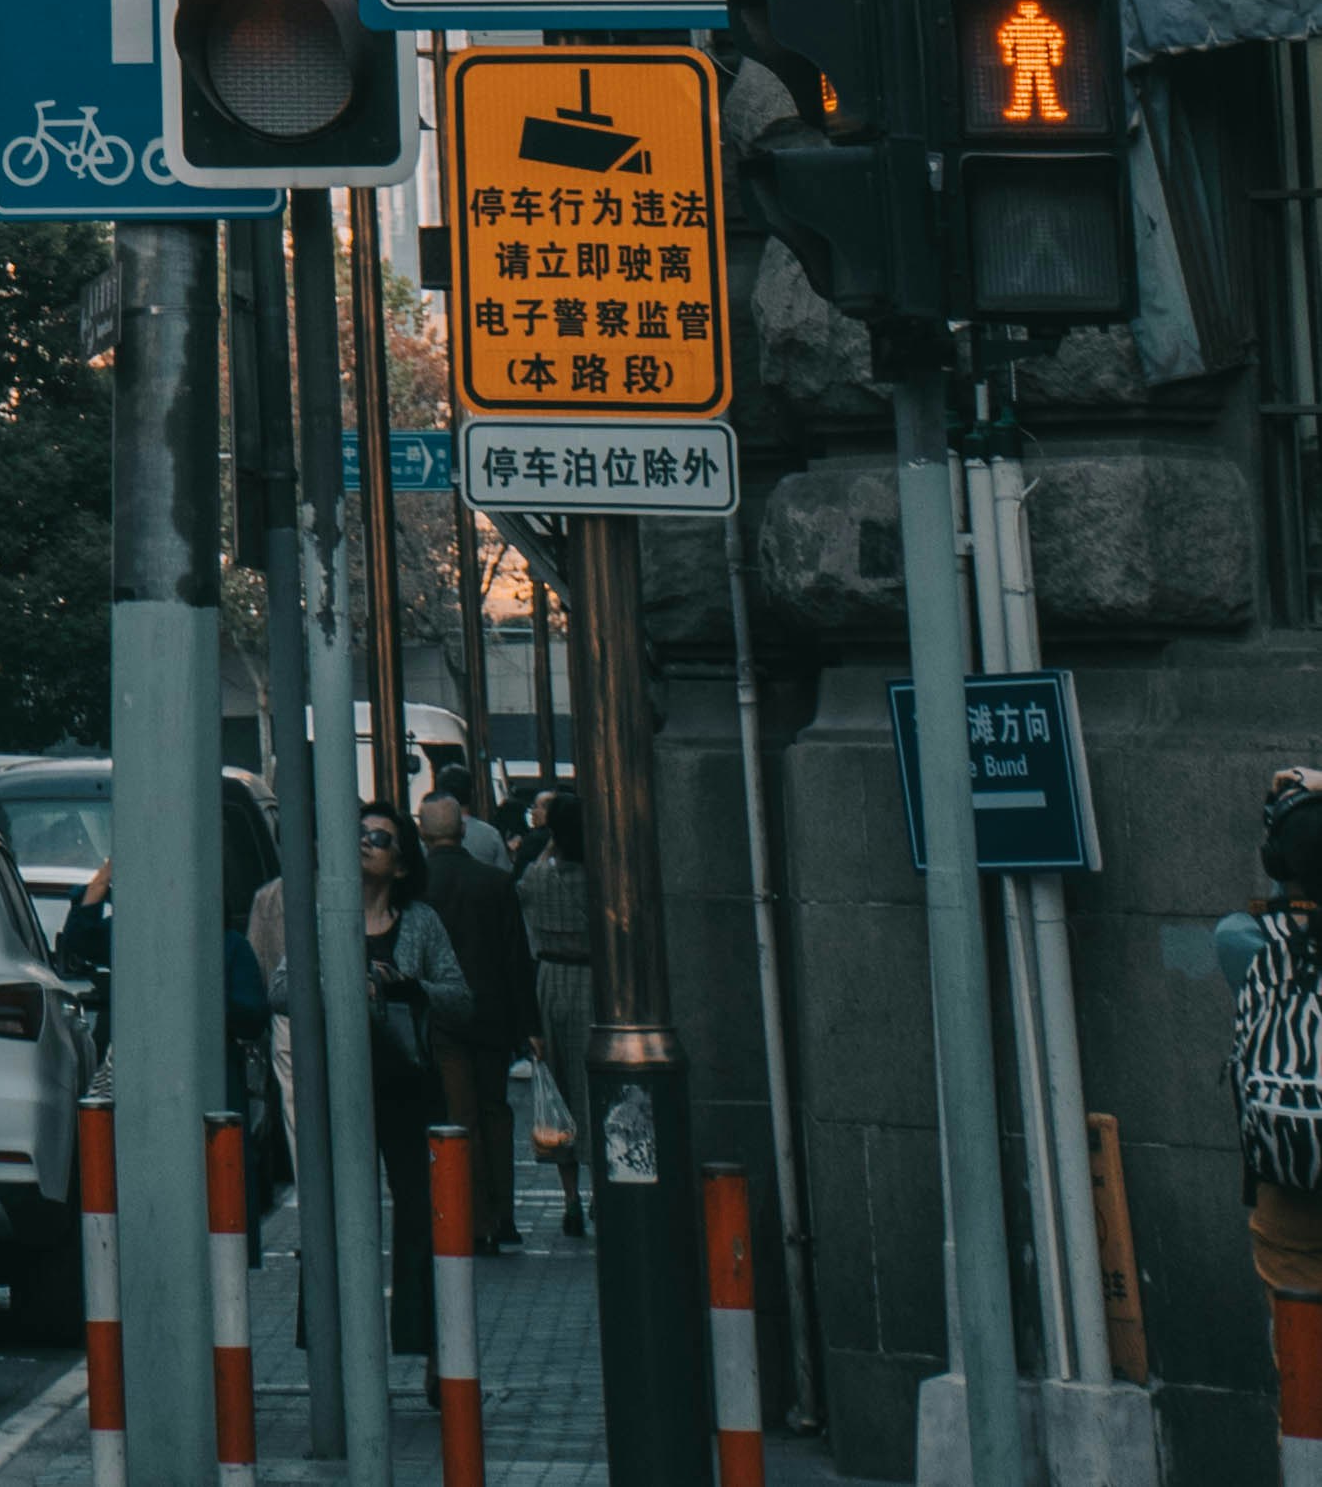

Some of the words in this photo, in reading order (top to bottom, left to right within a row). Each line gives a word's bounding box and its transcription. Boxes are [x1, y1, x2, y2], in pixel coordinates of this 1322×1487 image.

[469, 186, 708, 229] 停车行为违法
[495, 241, 692, 284] 请立即驶离
[475, 296, 710, 341] 电子警察监管
[507, 353, 675, 394] (本路段)
[481, 446, 719, 489] 停车泊位除外
[983, 753, 1029, 777] Bund
